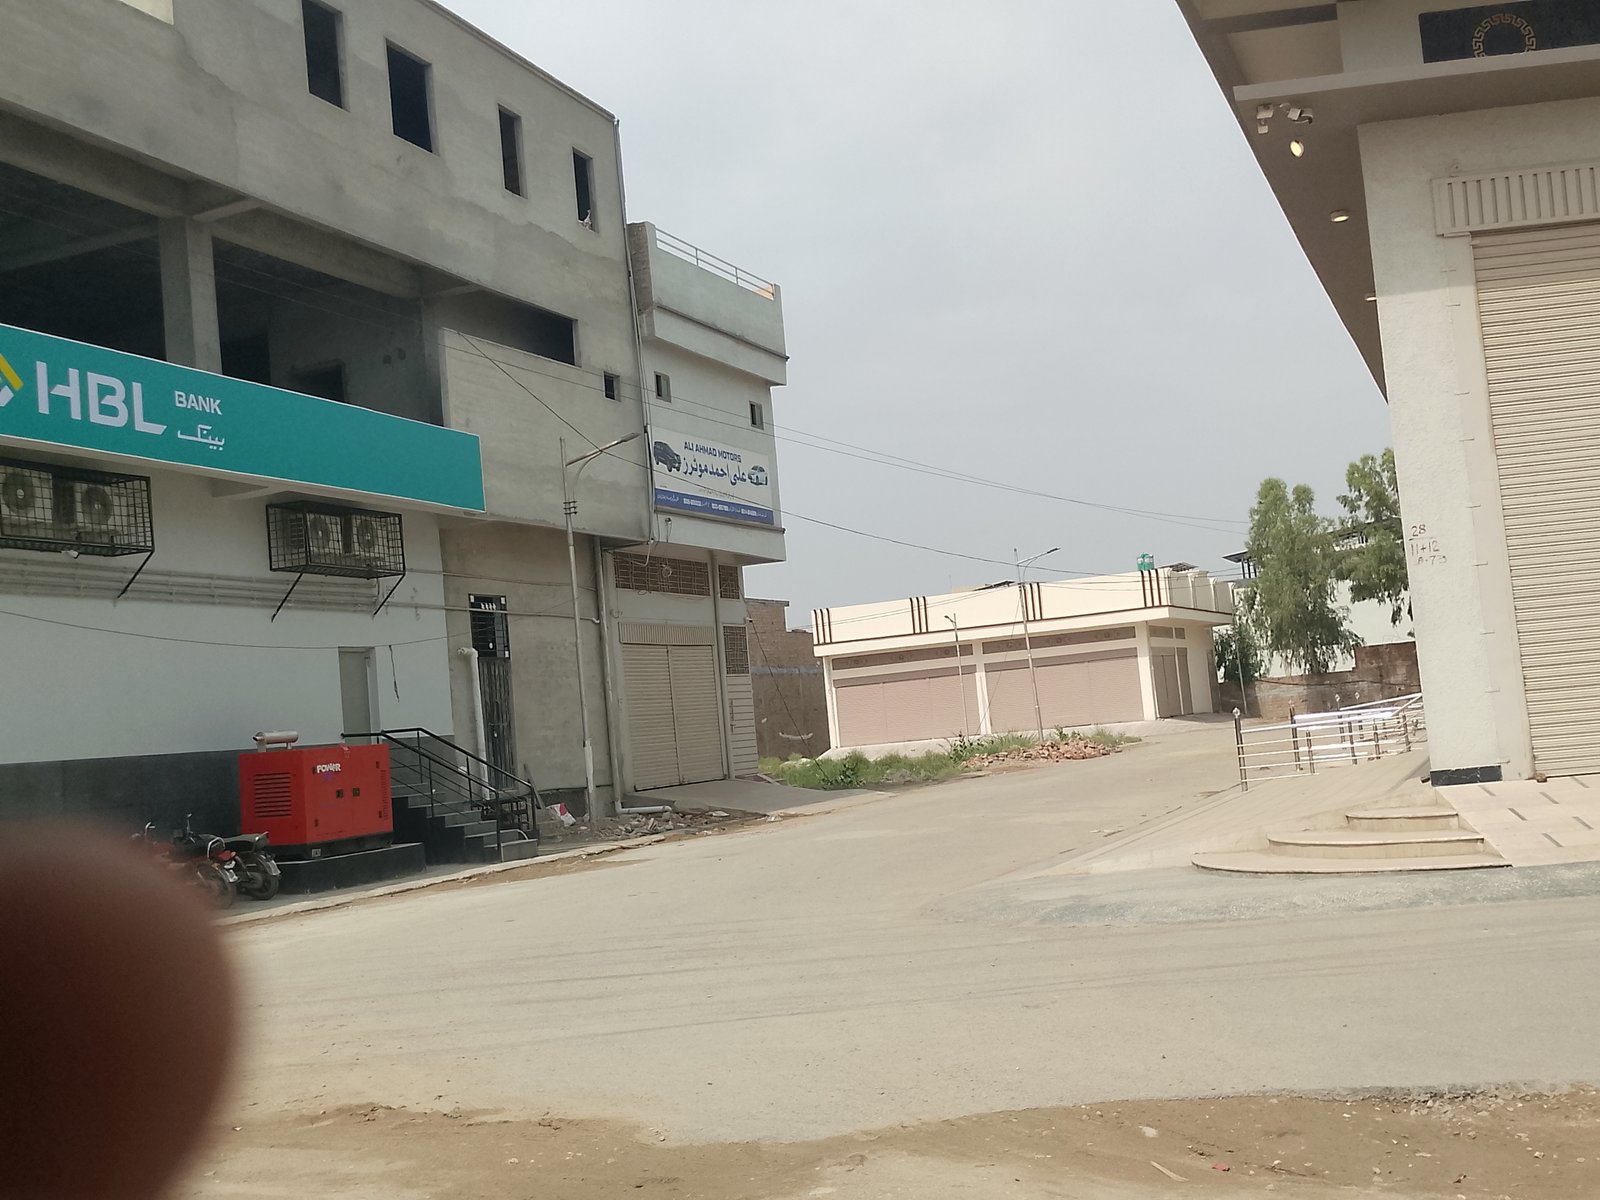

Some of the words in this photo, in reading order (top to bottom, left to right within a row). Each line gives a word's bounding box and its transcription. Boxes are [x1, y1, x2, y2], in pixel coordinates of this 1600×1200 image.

[36, 361, 167, 435] HBL
[174, 390, 223, 416] BANK
[684, 441, 694, 452] ALI
[695, 443, 717, 456] AHMAD
[717, 449, 742, 463] MOTORS
[709, 463, 730, 478] احمد
[1411, 524, 1426, 537] 28
